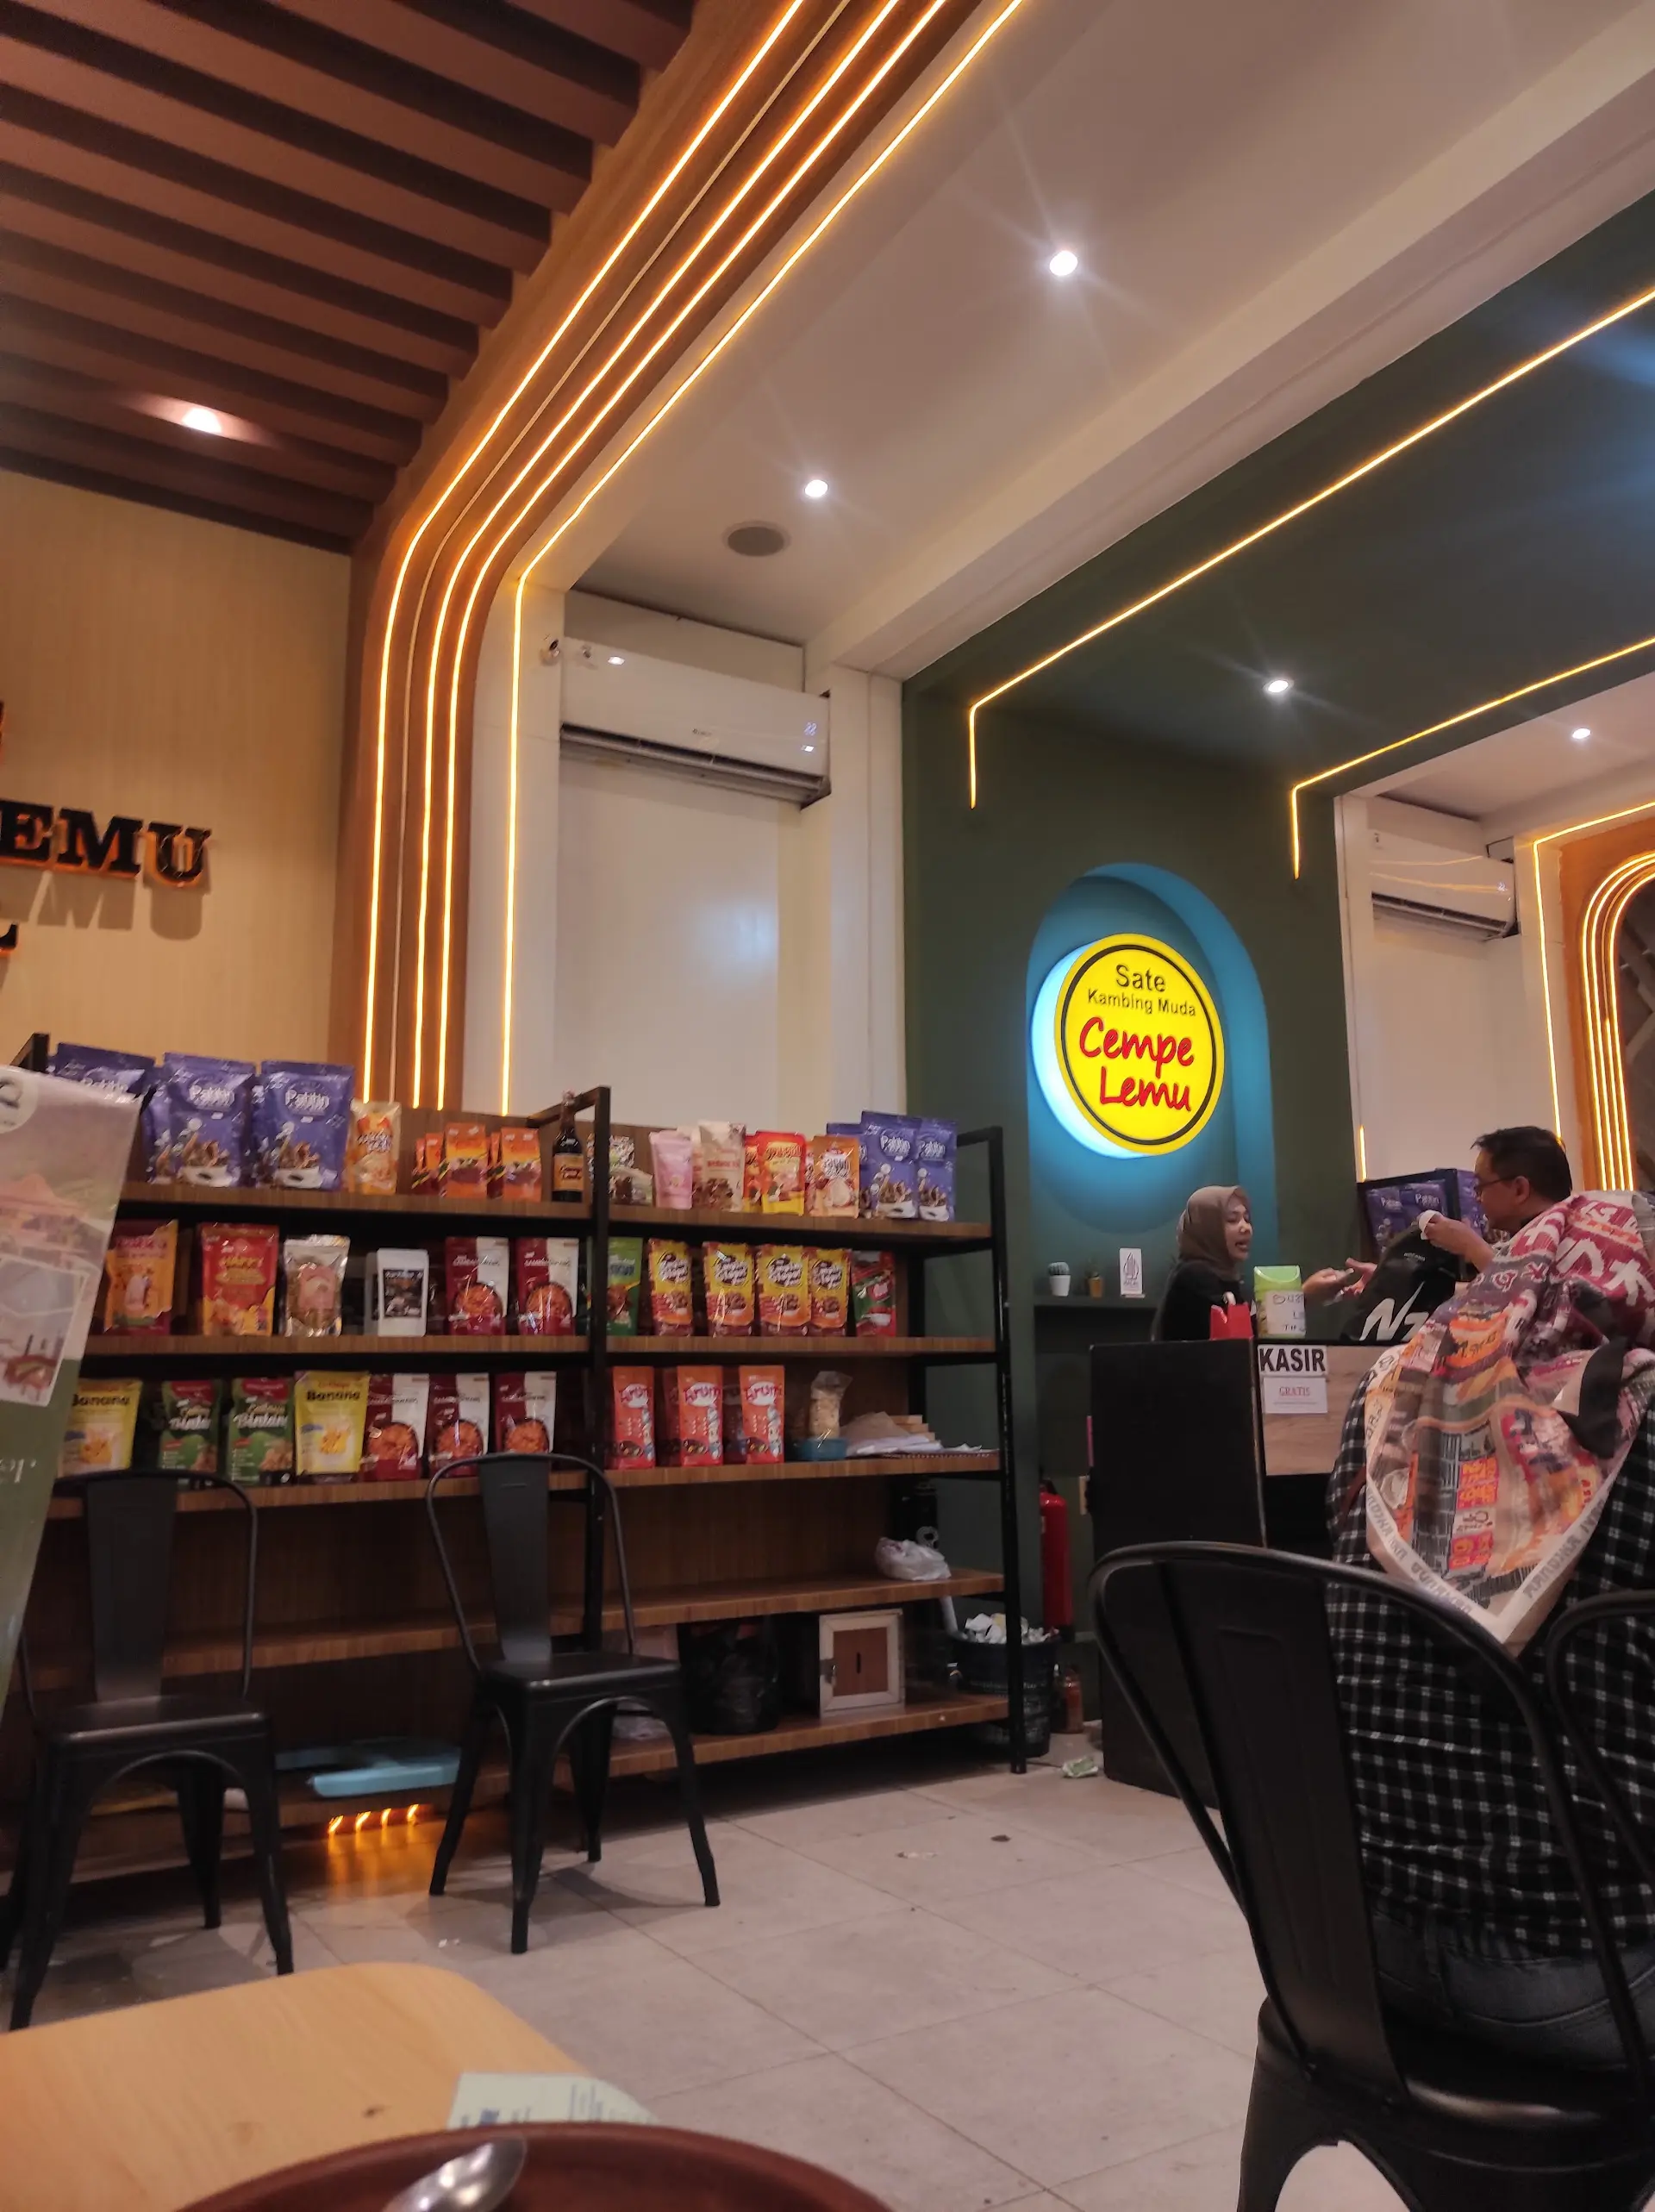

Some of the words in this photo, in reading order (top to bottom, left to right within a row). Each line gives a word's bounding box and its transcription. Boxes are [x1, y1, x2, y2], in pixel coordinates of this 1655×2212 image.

[1115, 964, 1166, 992] Sate
[1088, 988, 1153, 1015] Kambing
[1158, 997, 1196, 1017] Muda
[1079, 1016, 1195, 1078] Cempe
[1100, 1065, 1192, 1113] Lemu
[1259, 1348, 1326, 1372] KASIR
[1279, 1386, 1311, 1397] GRATIS
